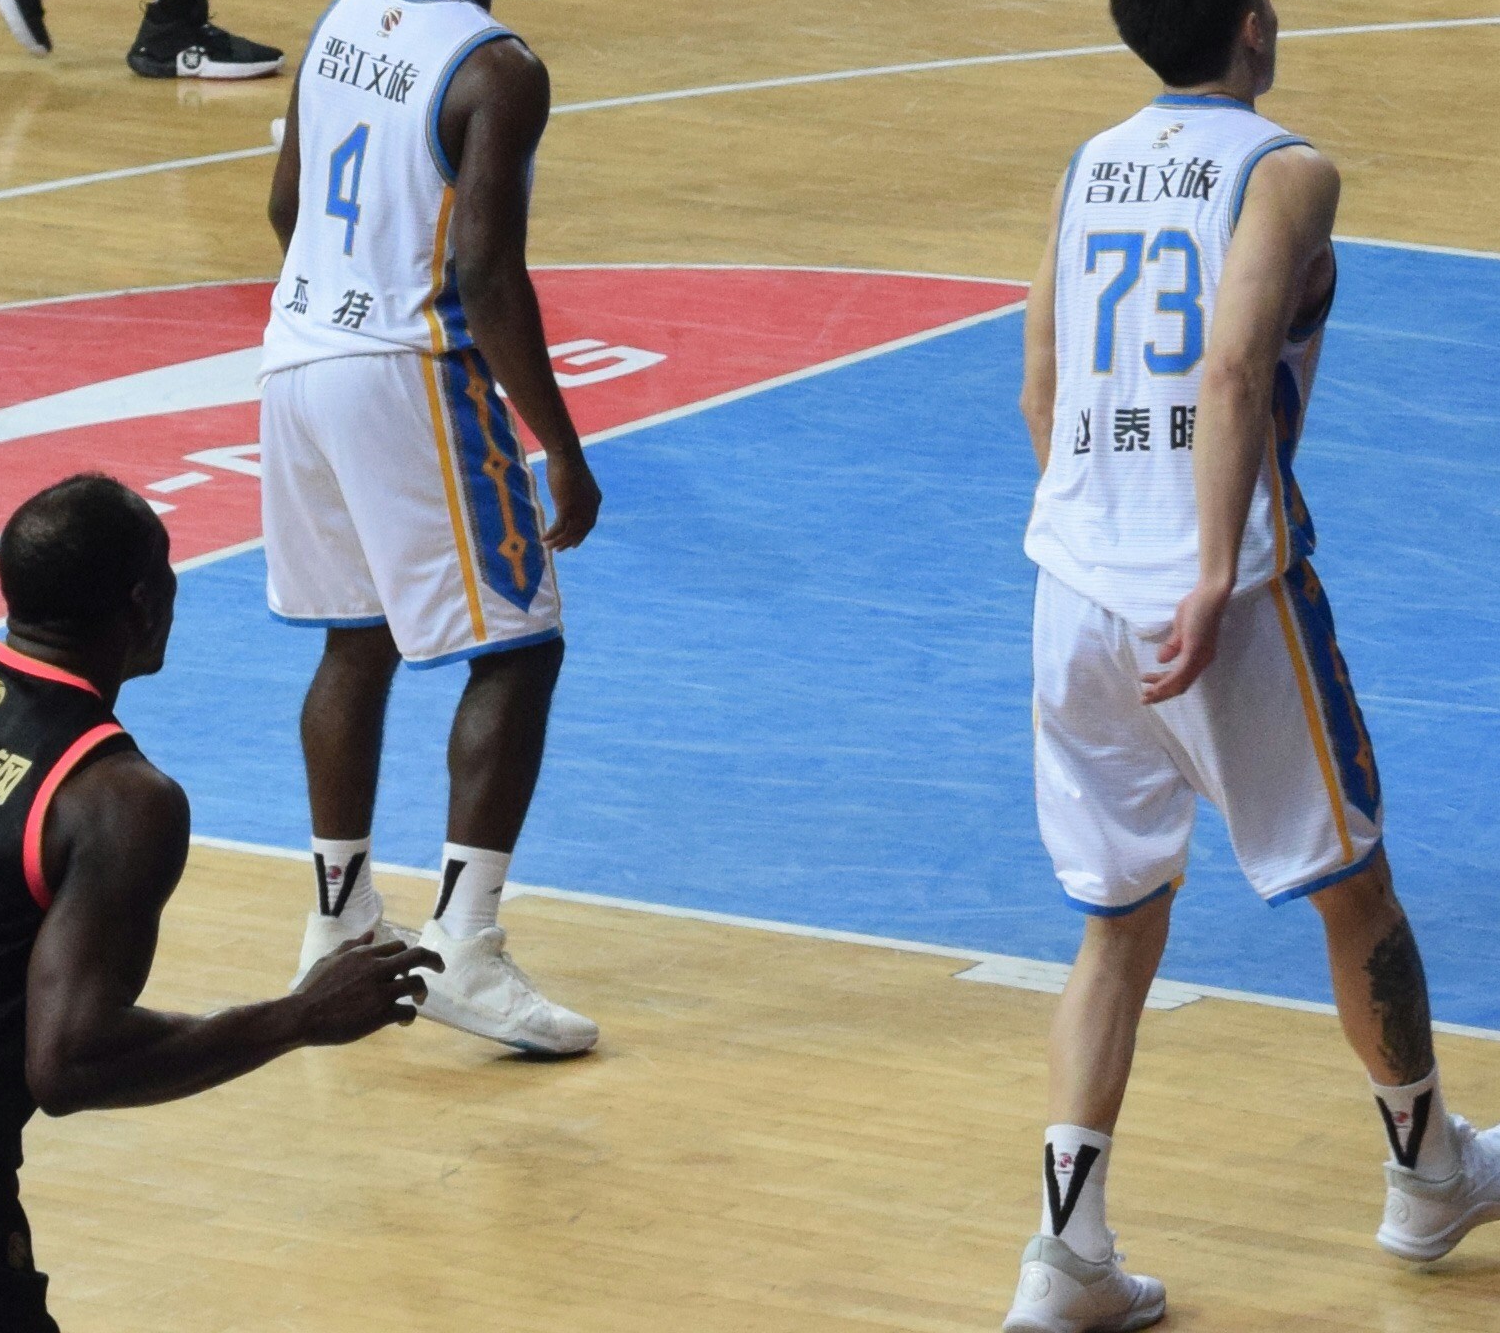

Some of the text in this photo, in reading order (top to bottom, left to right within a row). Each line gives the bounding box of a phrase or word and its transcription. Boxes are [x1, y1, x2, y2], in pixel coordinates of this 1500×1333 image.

[317, 35, 421, 105] 晋江文旅
[324, 121, 372, 258] 4
[1084, 156, 1223, 204] 晋江文旅
[1083, 226, 1206, 377] 73
